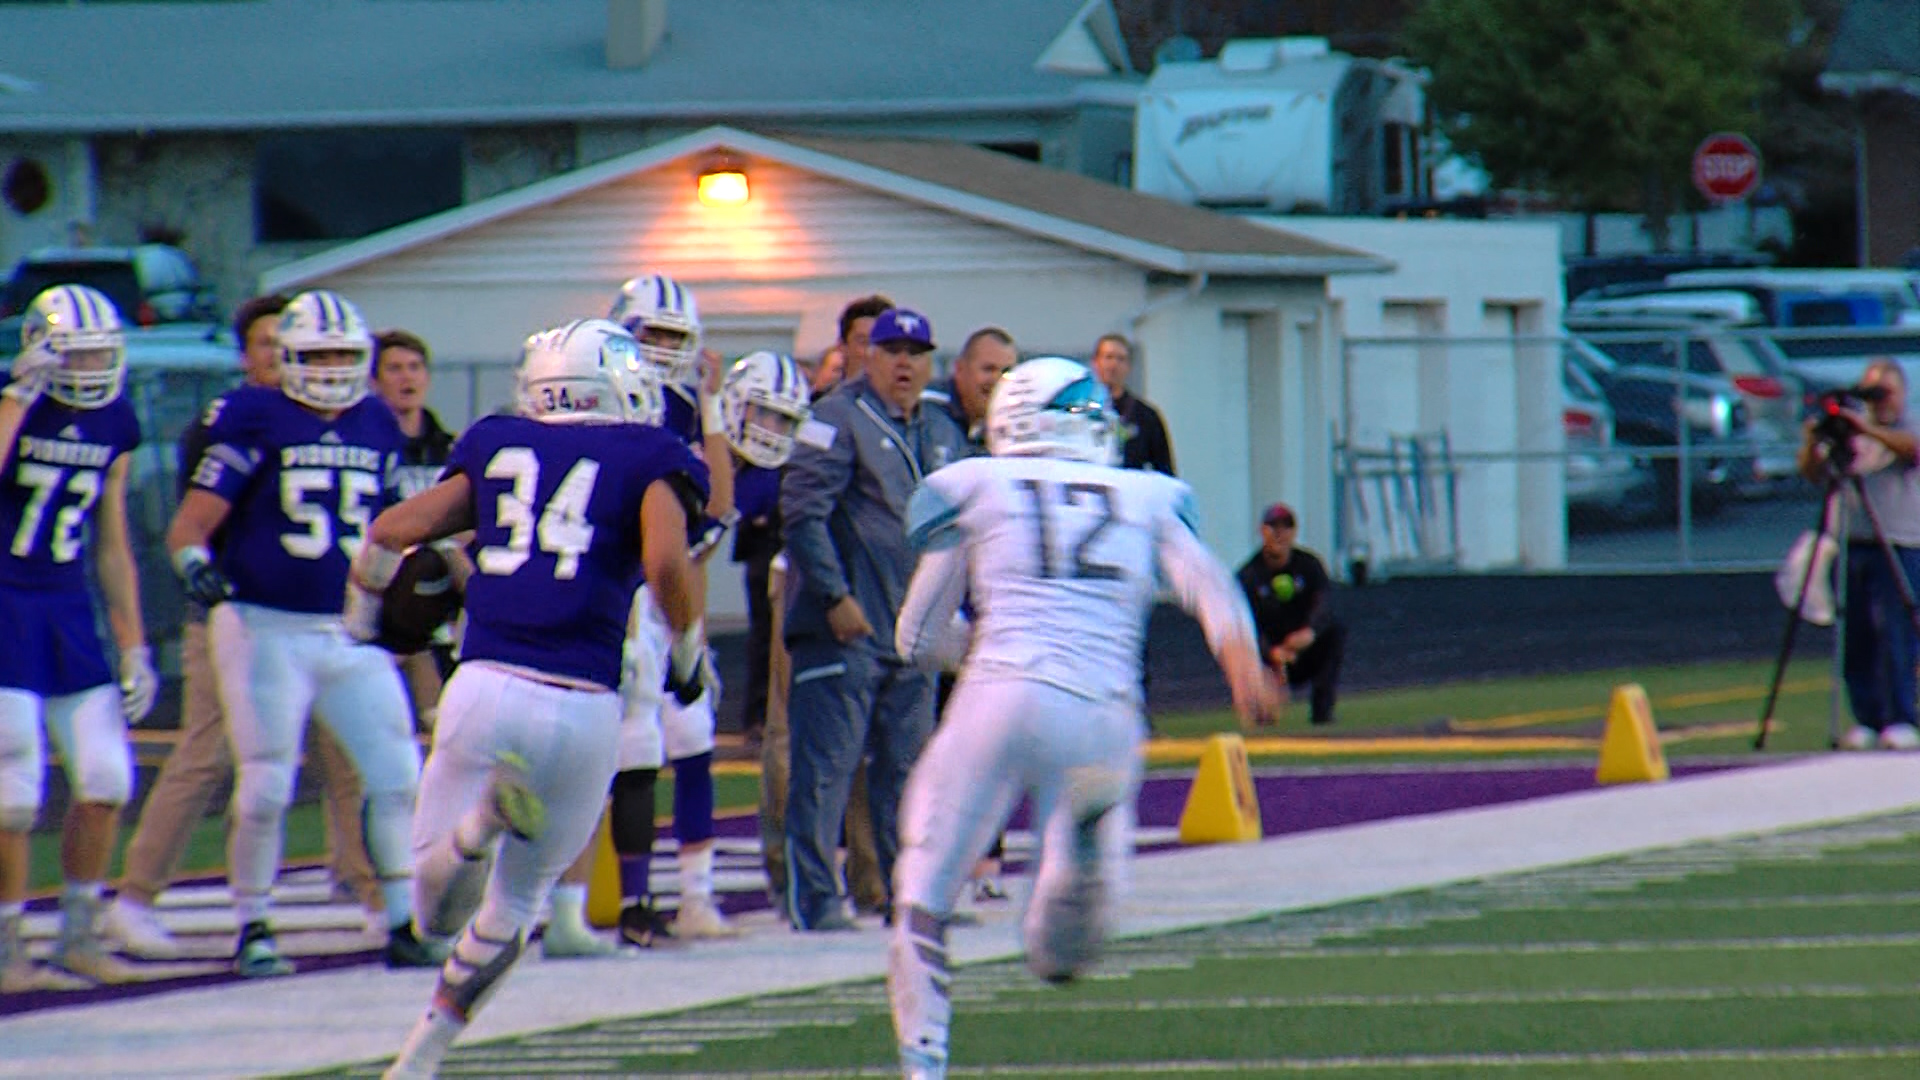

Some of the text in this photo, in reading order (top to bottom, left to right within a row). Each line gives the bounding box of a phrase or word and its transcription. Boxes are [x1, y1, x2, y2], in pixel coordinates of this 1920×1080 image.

[1703, 154, 1756, 178] STOP
[542, 387, 572, 411] 34
[10, 462, 100, 564] 72
[279, 468, 380, 561] 55
[476, 446, 600, 580] 34
[1015, 479, 1128, 580] 12
